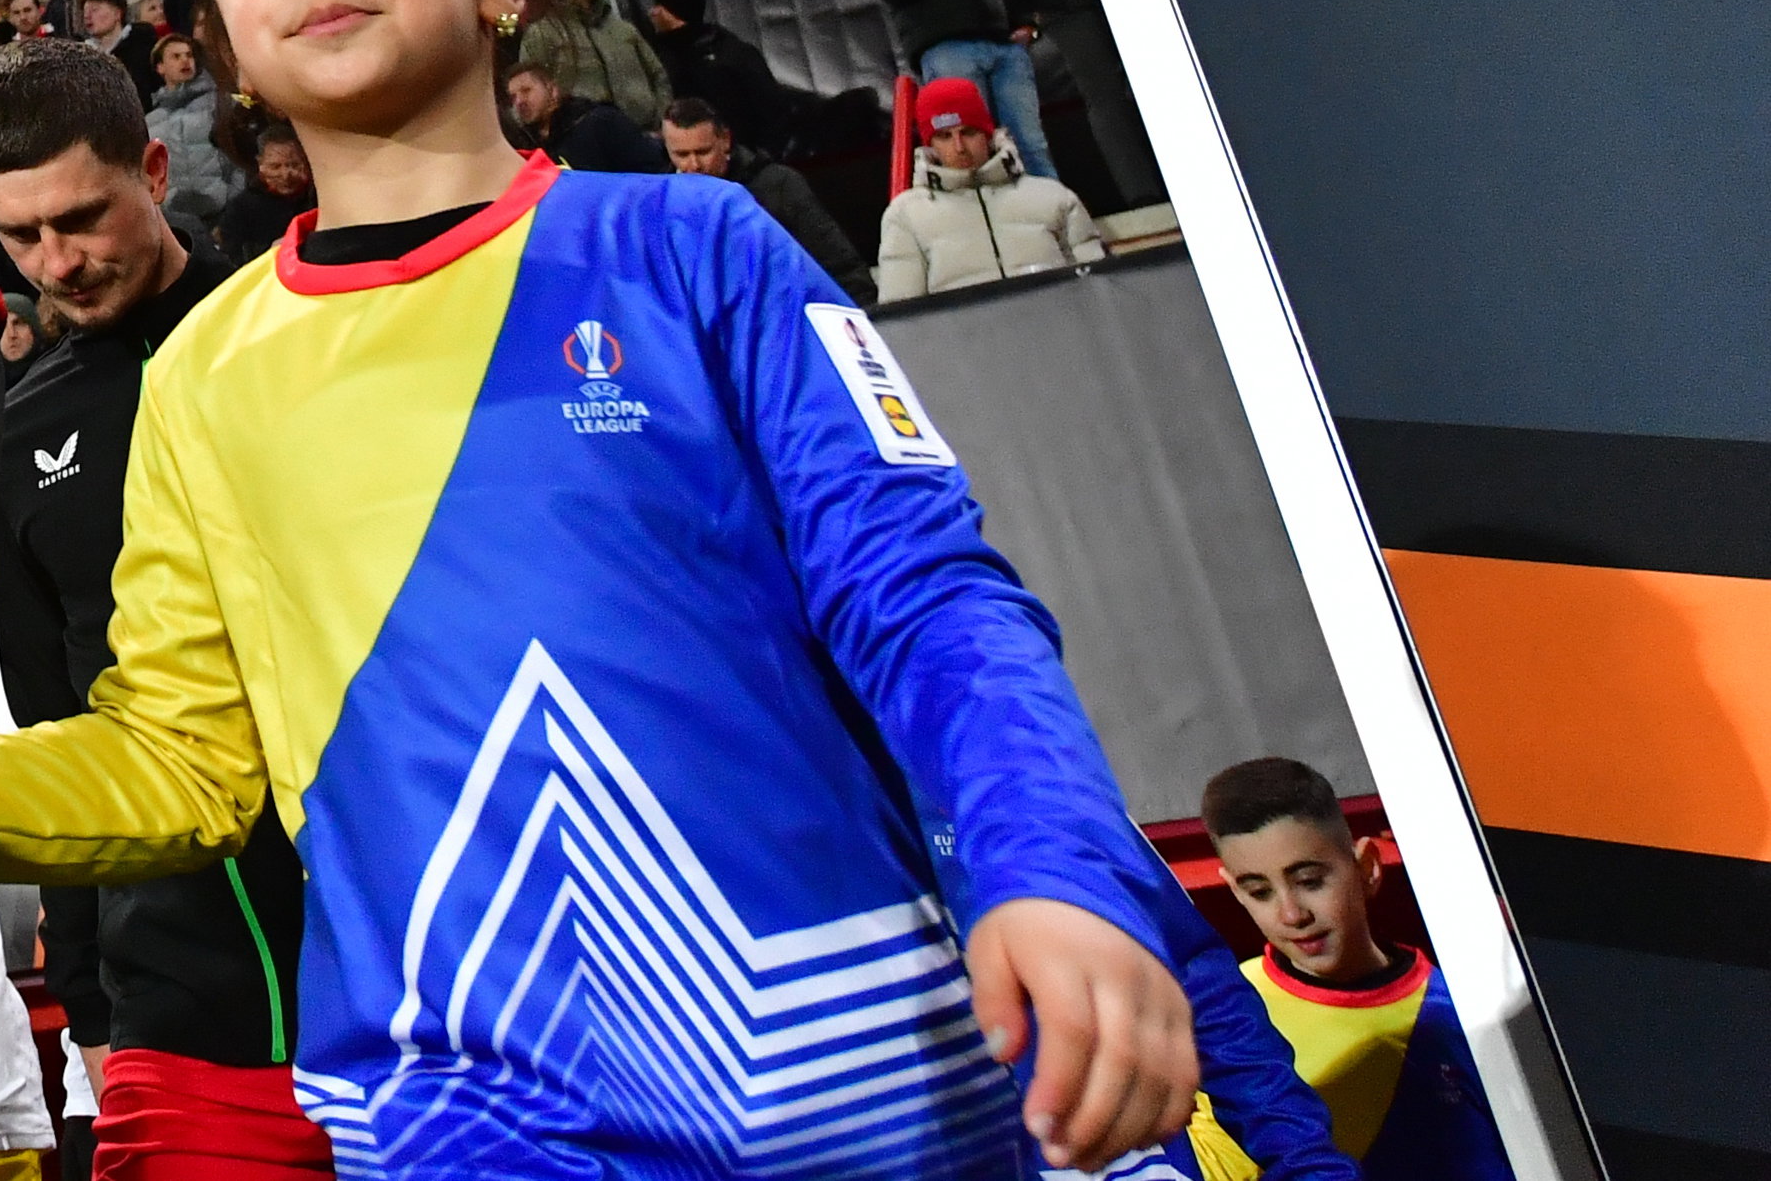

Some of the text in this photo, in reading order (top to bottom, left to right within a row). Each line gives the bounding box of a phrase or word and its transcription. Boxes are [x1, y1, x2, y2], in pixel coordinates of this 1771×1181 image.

[561, 400, 651, 419] EUROPA
[572, 418, 643, 434] LEAGUE
[37, 463, 81, 490] CASTORE
